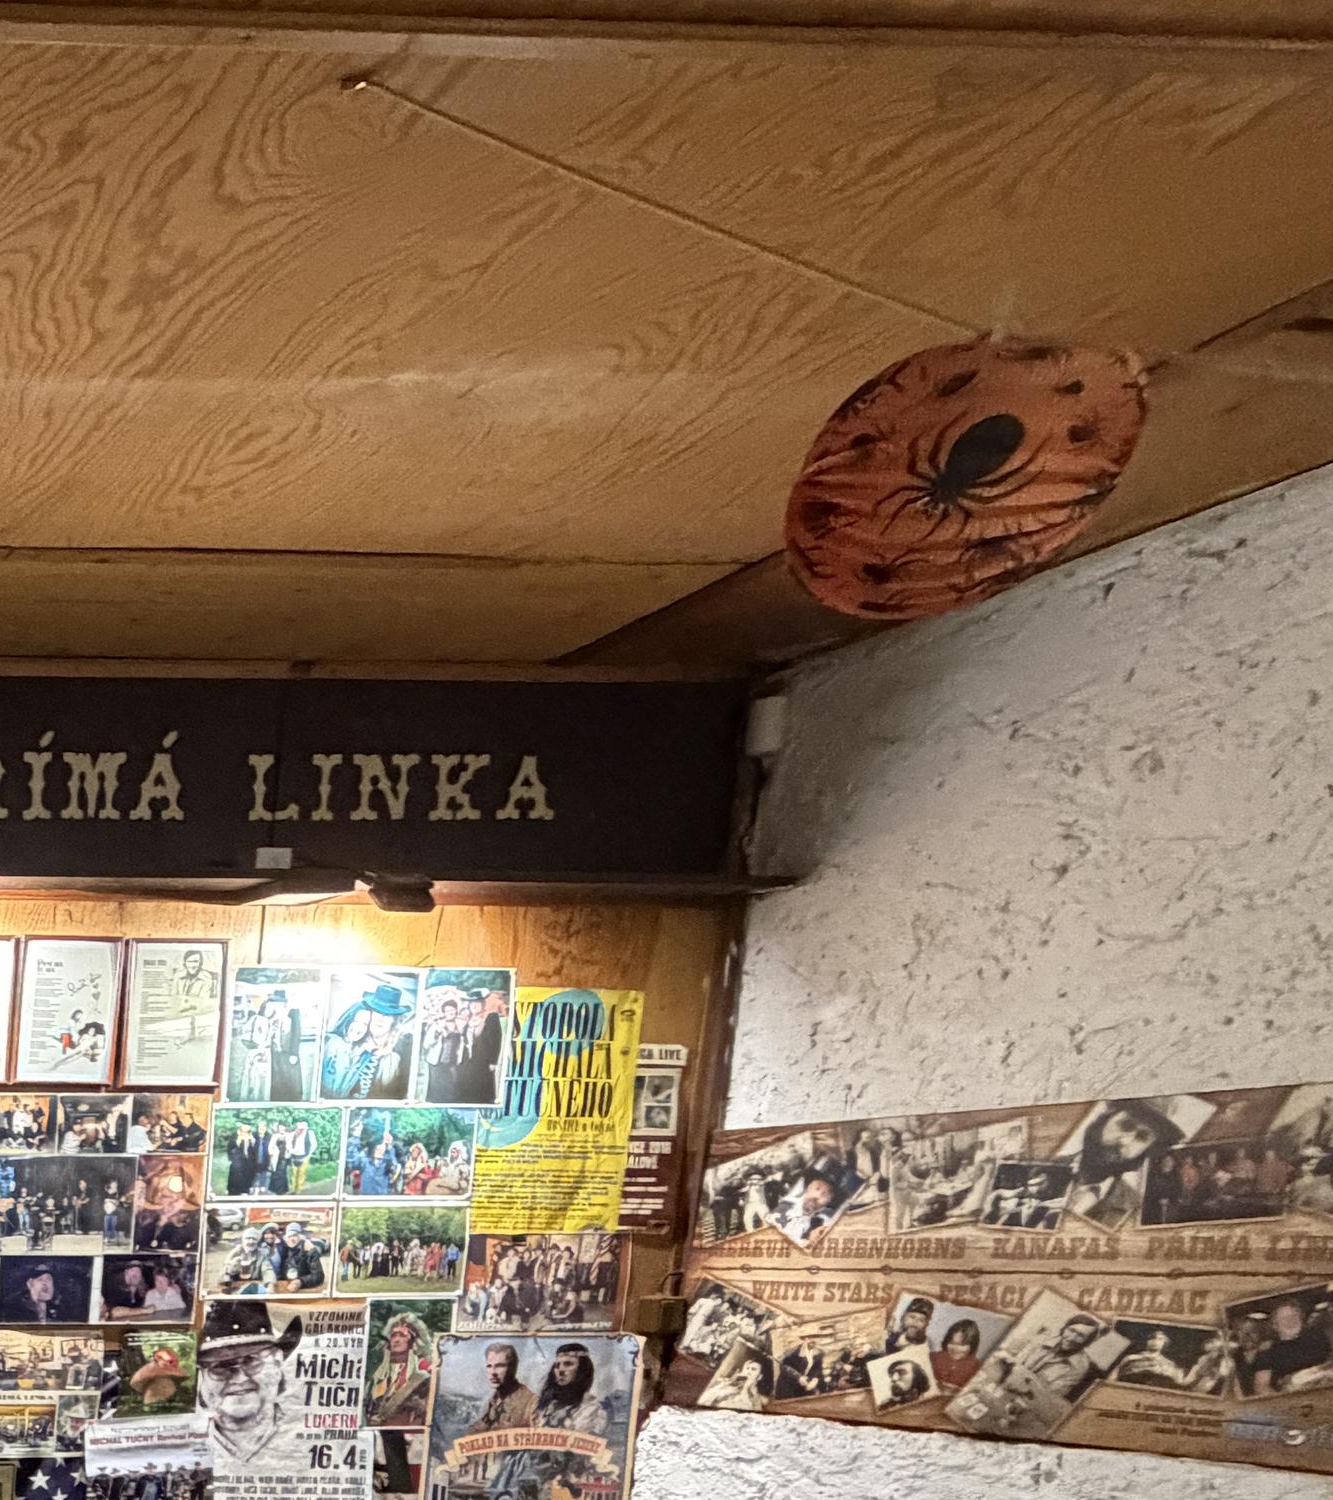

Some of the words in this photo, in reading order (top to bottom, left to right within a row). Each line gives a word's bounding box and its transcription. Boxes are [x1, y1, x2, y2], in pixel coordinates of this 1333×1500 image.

[249, 753, 556, 821] LINKA
[752, 1281, 817, 1302] WHITE
[821, 1282, 894, 1303] STARS
